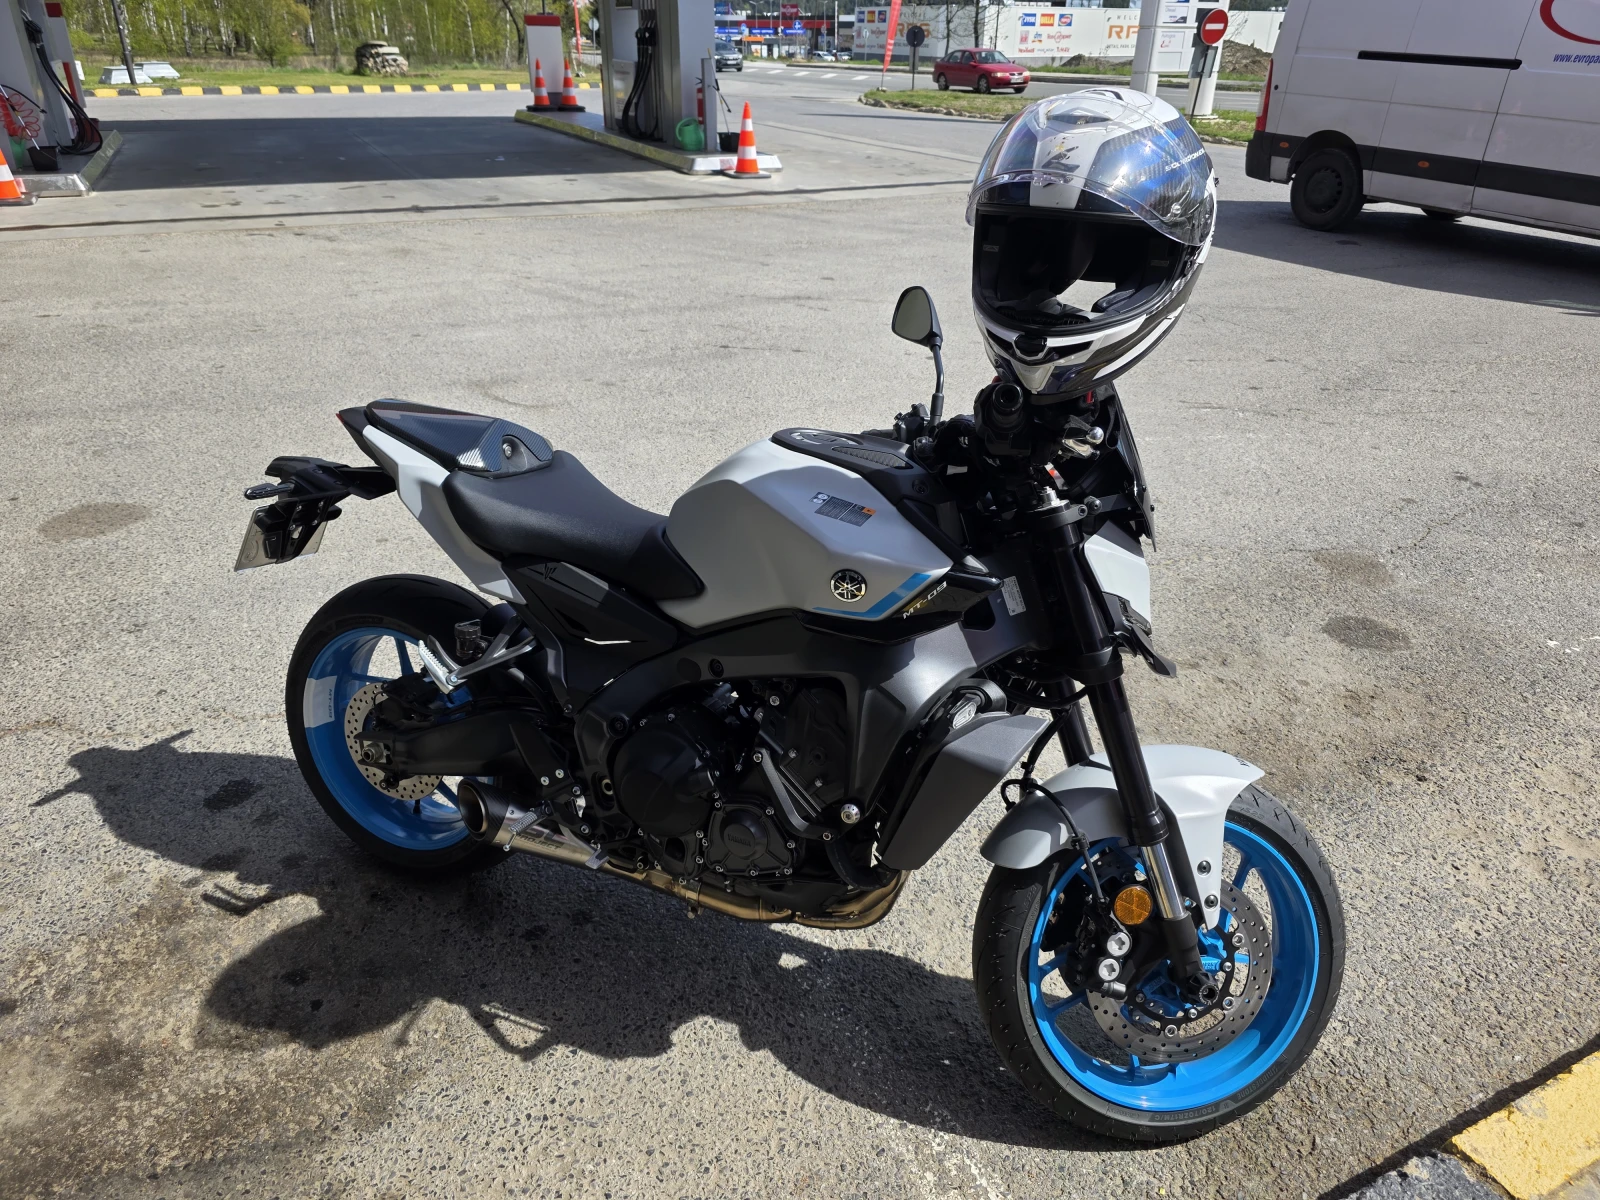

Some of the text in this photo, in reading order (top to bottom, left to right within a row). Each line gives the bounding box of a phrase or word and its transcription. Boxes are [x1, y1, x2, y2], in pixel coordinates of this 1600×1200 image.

[1108, 24, 1139, 39] RP
[903, 581, 947, 619] MT-09
[516, 834, 564, 850] ROJECT
